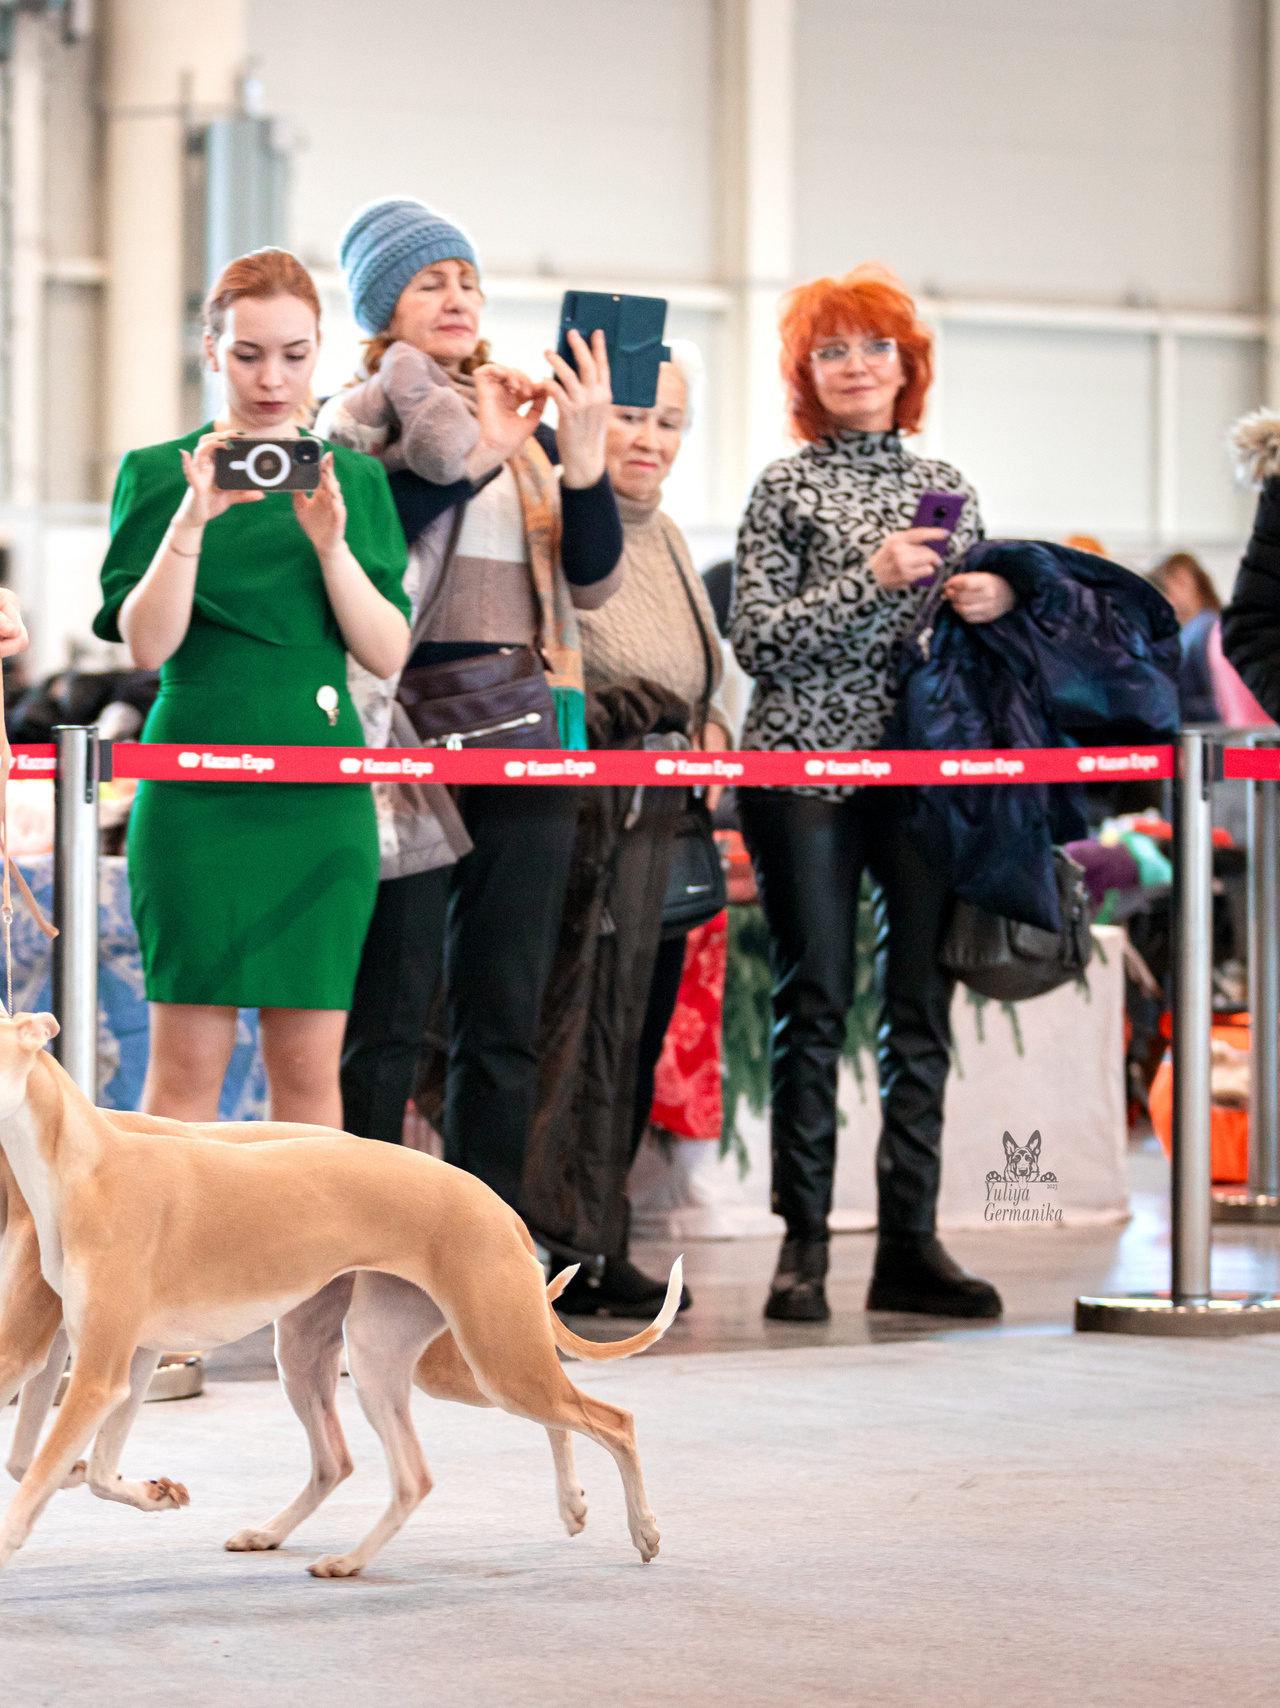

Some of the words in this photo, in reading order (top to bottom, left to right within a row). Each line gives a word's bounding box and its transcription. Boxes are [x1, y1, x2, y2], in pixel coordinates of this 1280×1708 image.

[17, 754, 56, 770] Kazan
[201, 753, 241, 769] Kazan
[241, 753, 275, 773] Expo
[363, 758, 401, 774] Kazan
[401, 758, 434, 777] Expo
